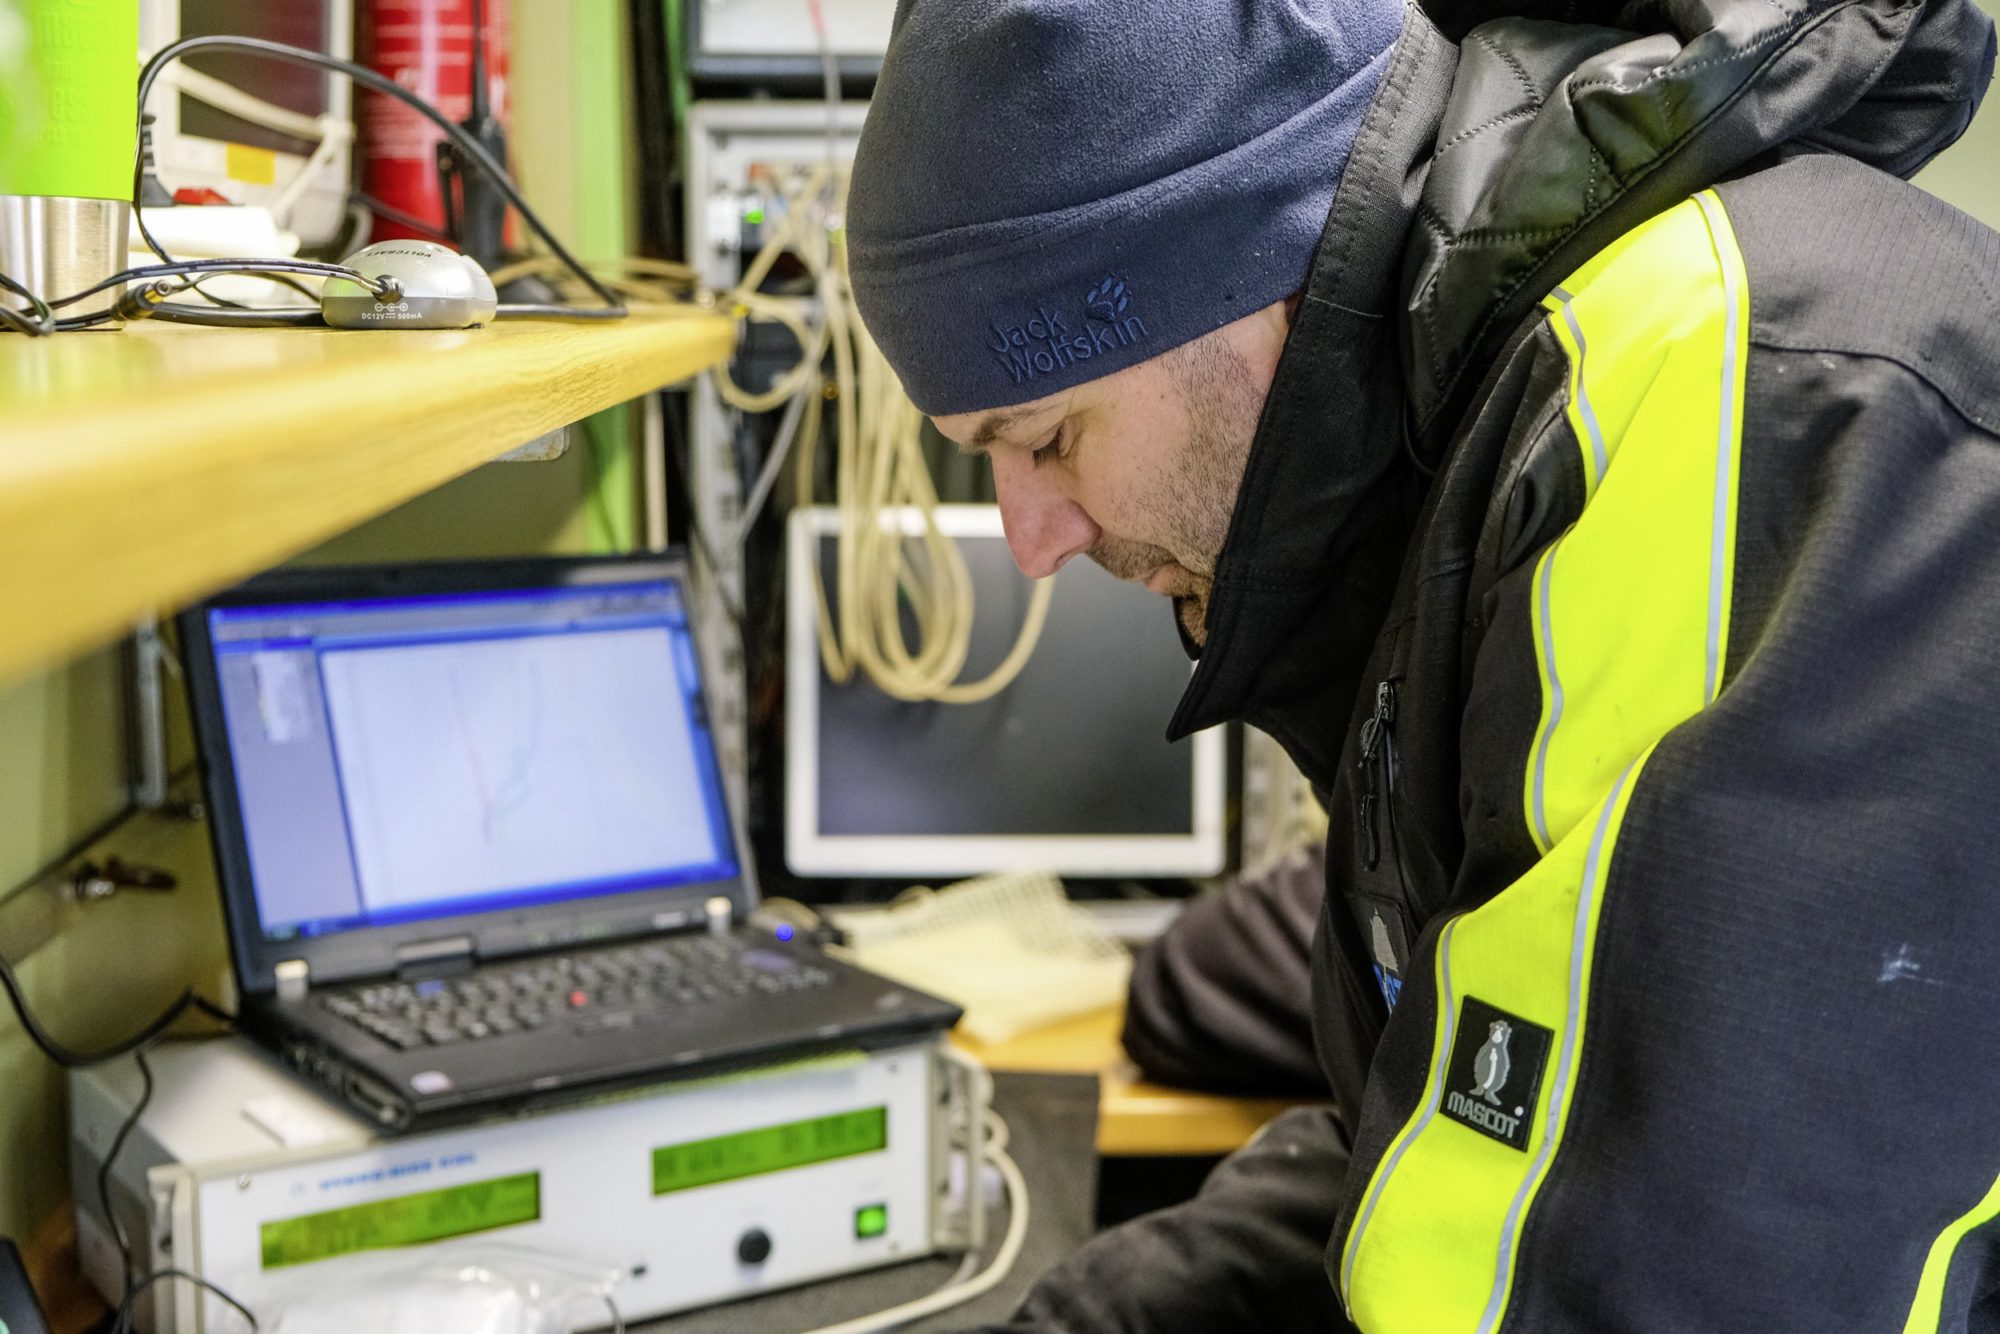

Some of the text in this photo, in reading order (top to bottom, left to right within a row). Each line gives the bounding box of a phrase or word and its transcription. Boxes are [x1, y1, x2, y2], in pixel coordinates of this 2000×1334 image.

[991, 307, 1067, 353] Jack
[1000, 316, 1149, 384] Wolfskin
[1447, 1091, 1520, 1139] MASCOT
